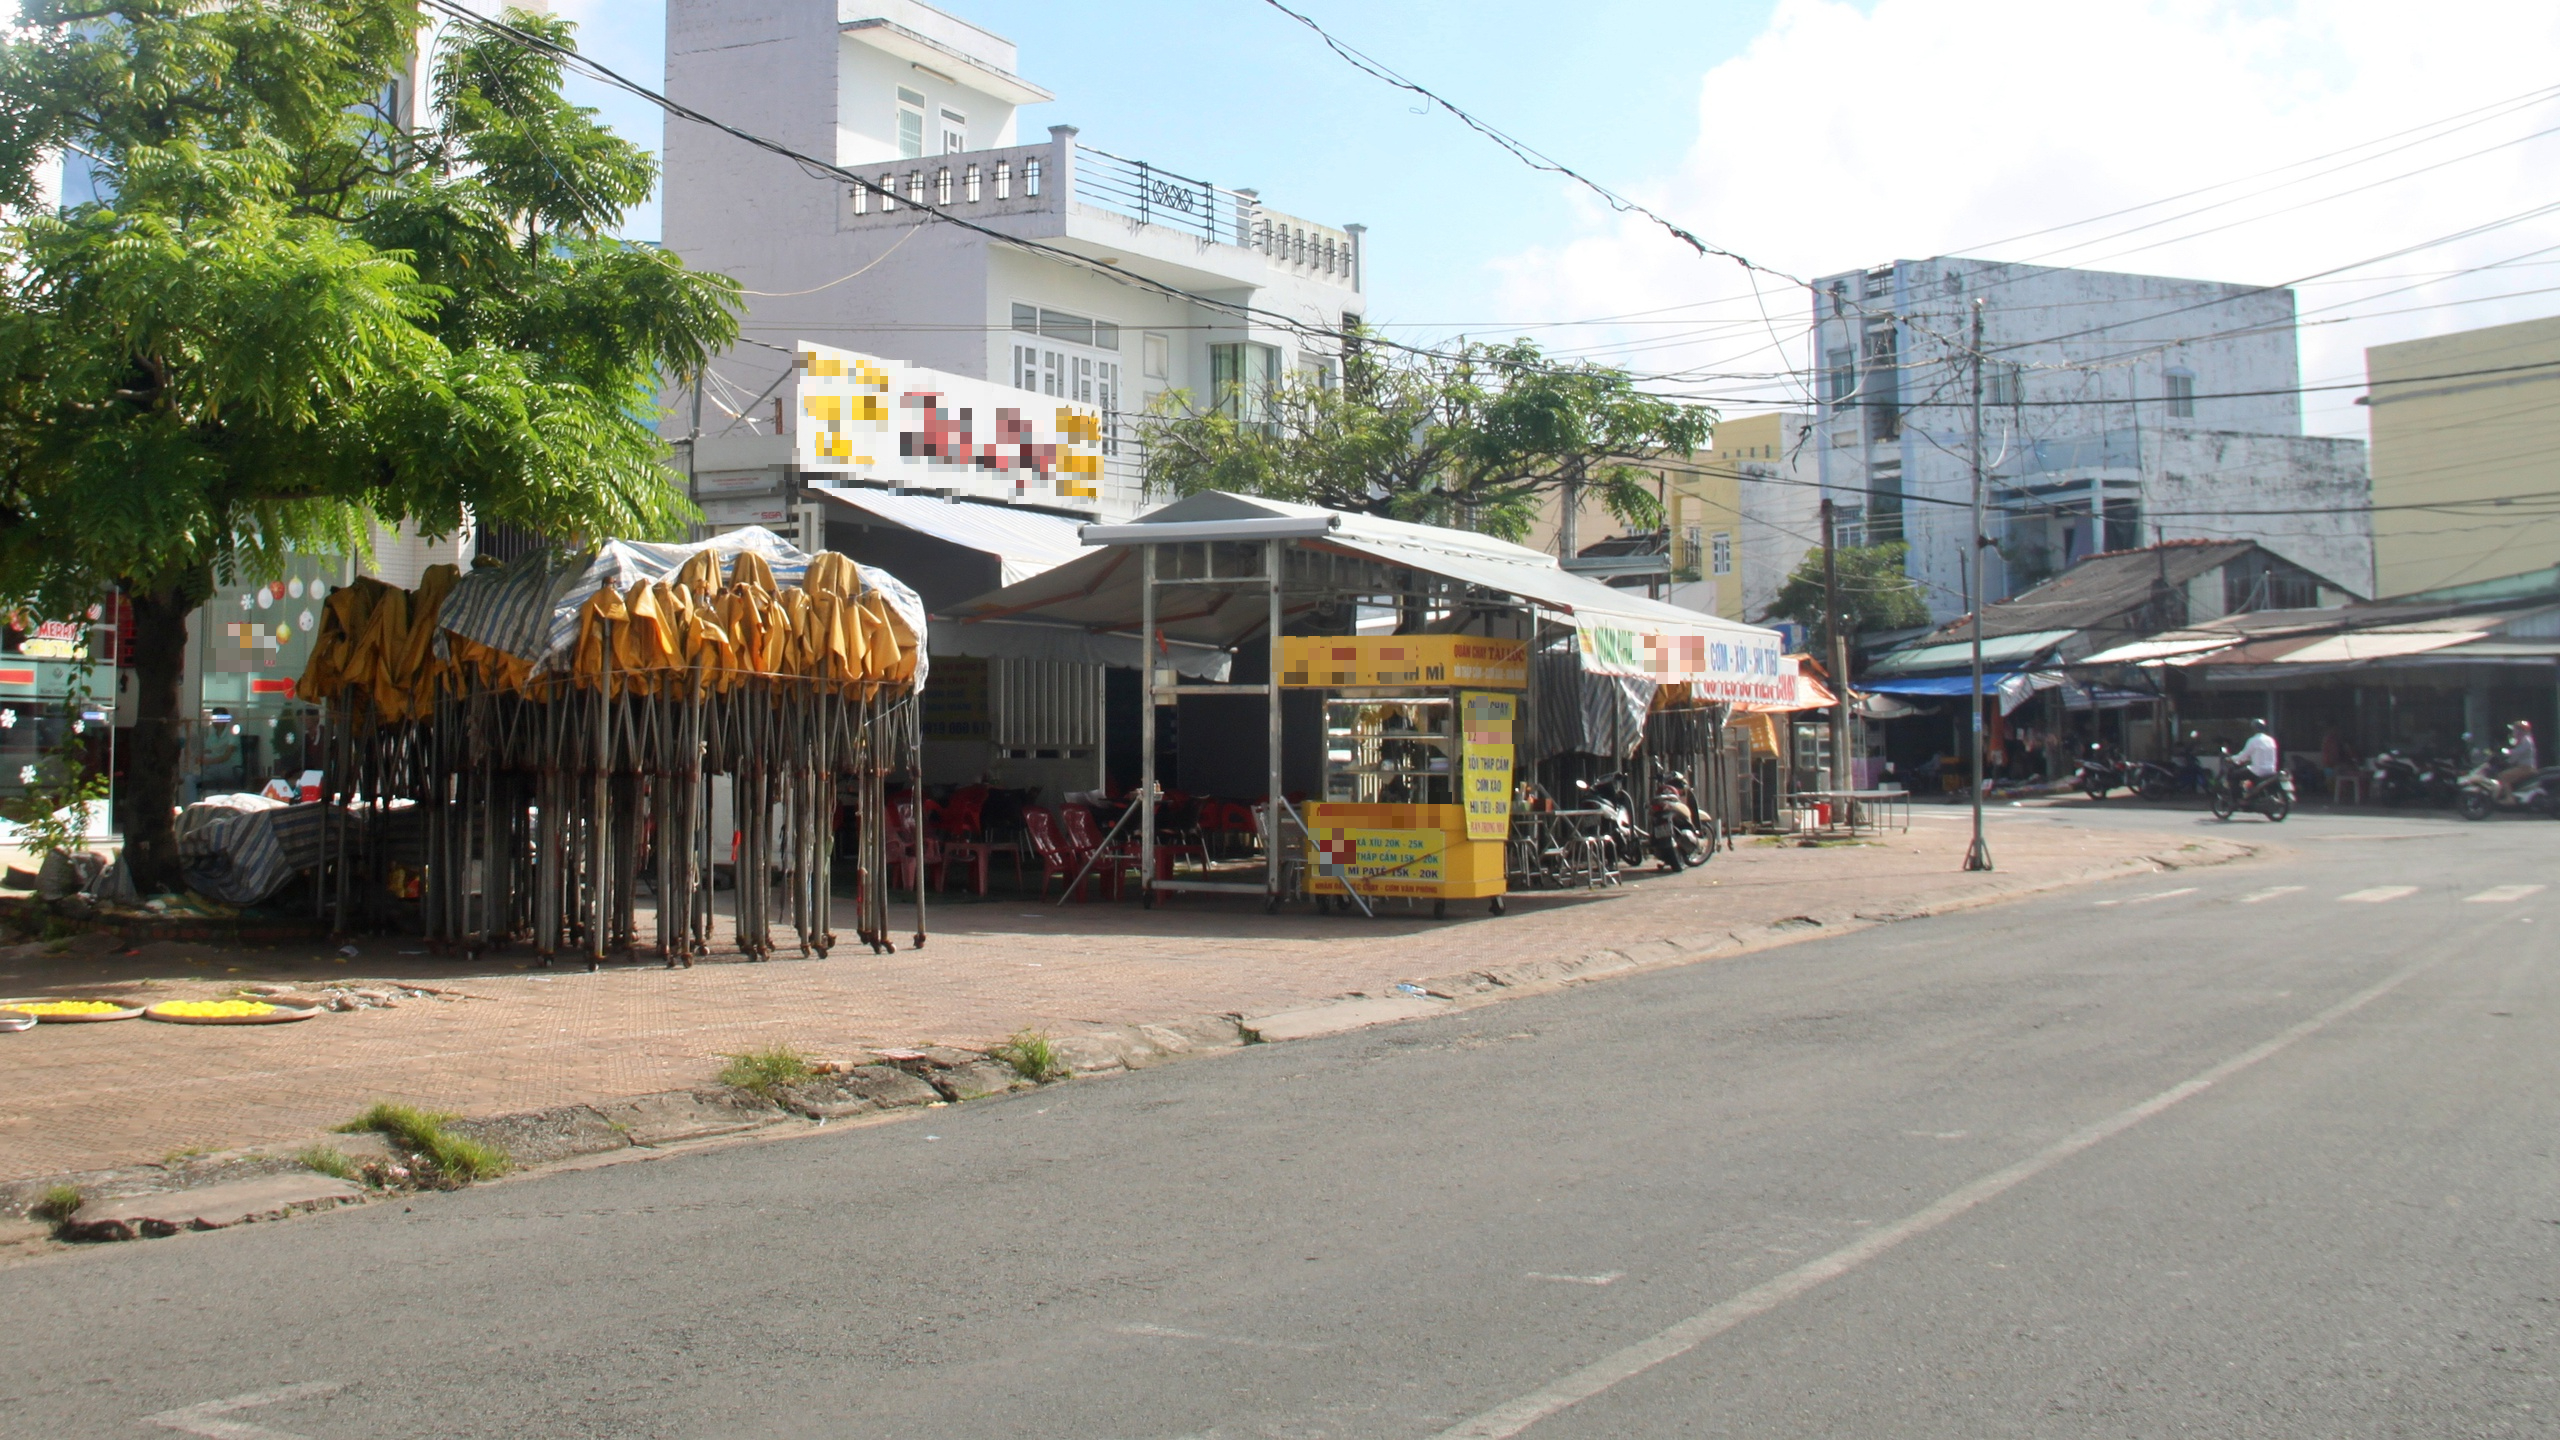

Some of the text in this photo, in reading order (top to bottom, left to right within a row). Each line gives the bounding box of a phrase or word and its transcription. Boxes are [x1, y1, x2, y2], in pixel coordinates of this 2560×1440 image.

[37, 621, 77, 638] MERRY
[1385, 839, 1401, 848] 20K
[1408, 840, 1424, 849] 25K
[1420, 869, 1438, 879] 20K
